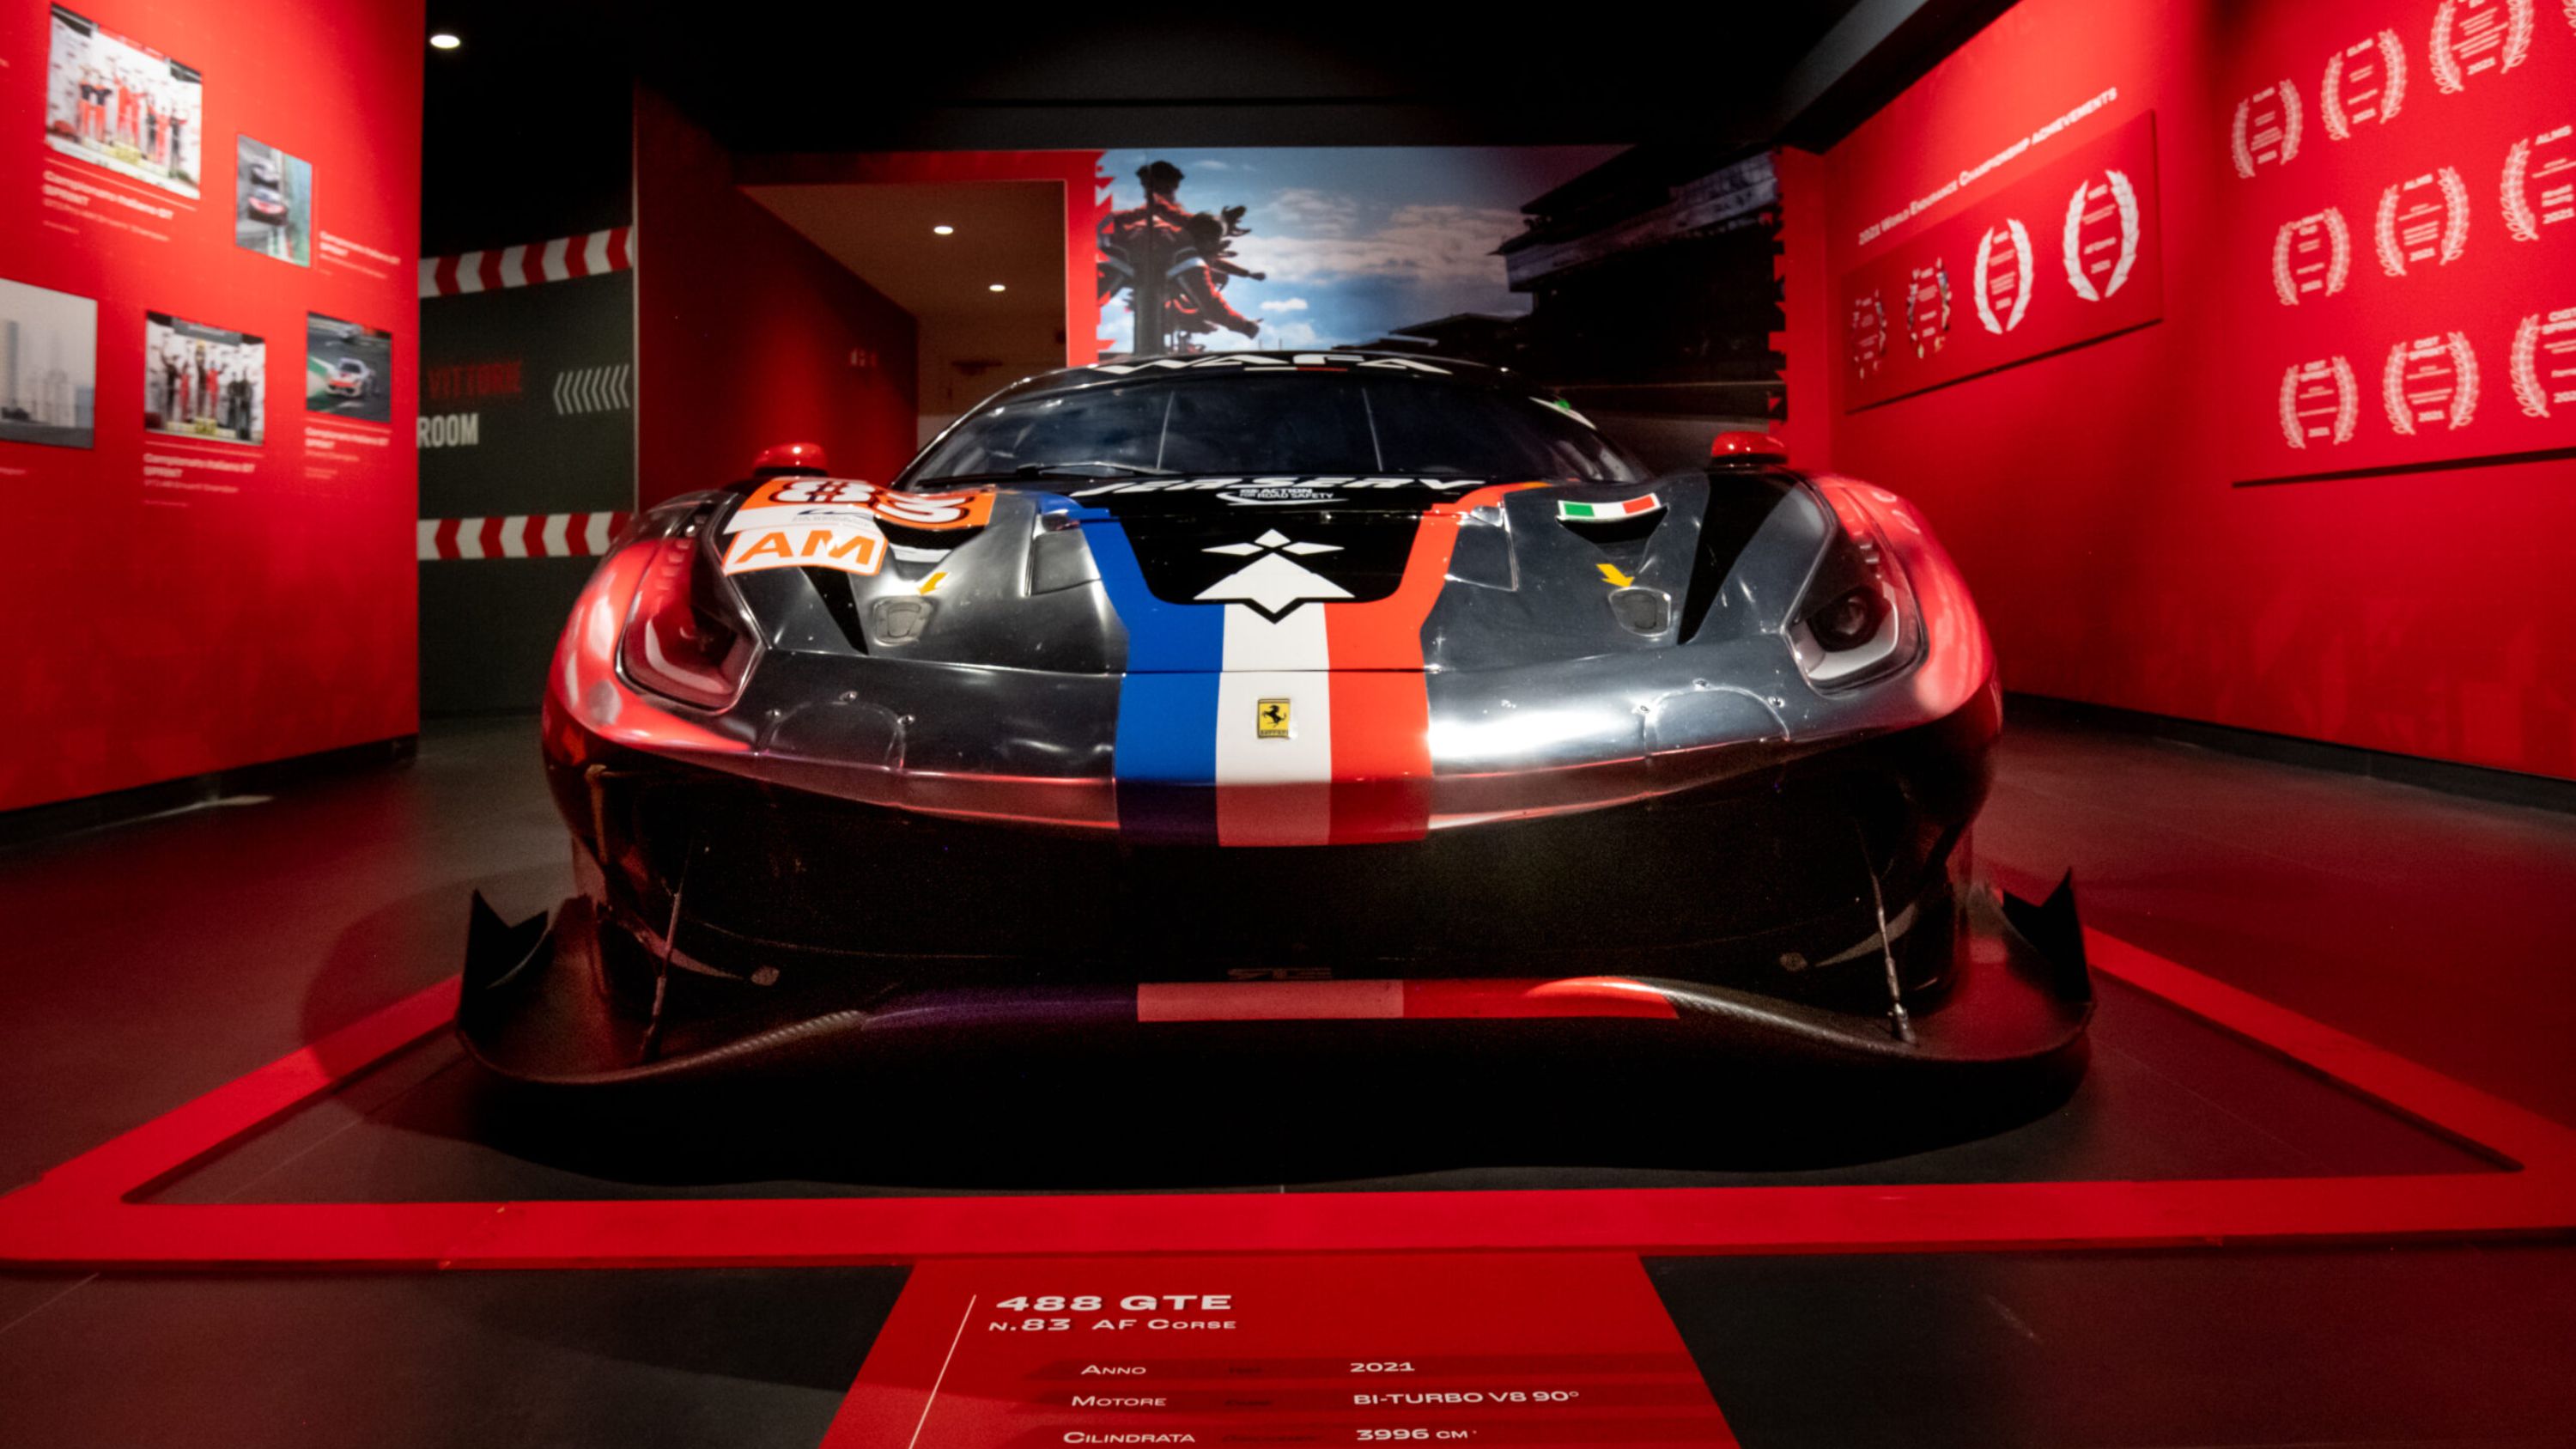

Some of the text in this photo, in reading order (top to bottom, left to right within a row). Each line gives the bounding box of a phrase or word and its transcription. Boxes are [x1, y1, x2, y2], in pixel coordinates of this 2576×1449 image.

[416, 412, 479, 448] ROOM
[734, 529, 878, 565] AM
[996, 1295, 1232, 1311] 488 GTE
[1091, 1319, 1138, 1330] AF
[1350, 1362, 1415, 1373] 2021
[1353, 1392, 1484, 1404] BI-TURBO
[1488, 1391, 1527, 1402] V8
[1356, 1428, 1430, 1440] 3996
